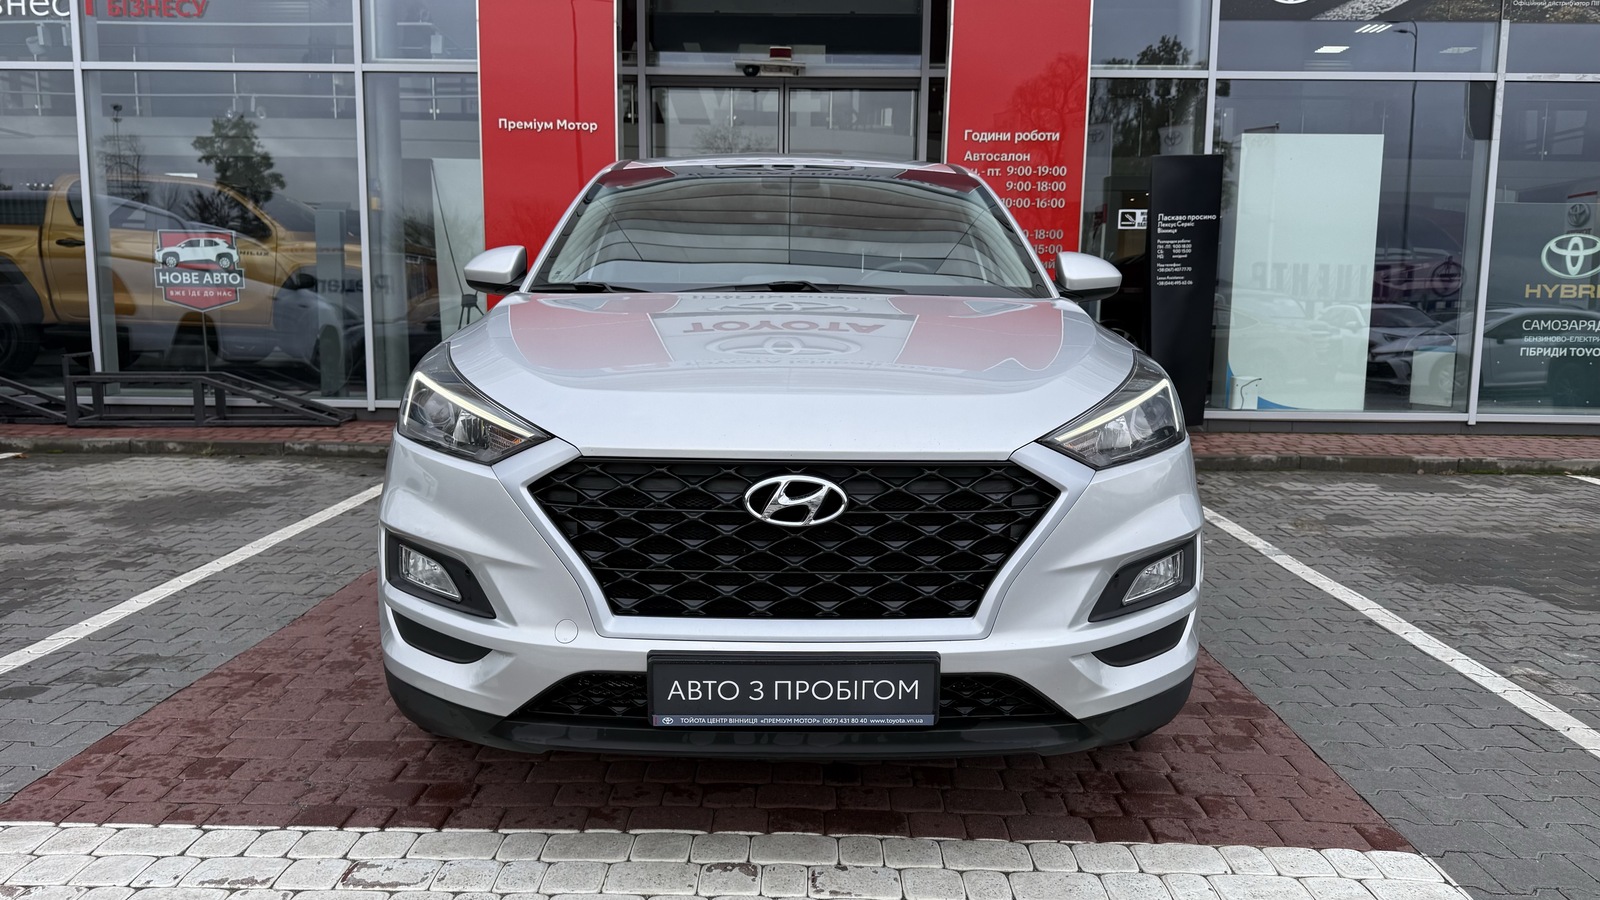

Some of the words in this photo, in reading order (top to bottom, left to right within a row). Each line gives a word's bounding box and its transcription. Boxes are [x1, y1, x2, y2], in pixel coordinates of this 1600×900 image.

[0, 0, 71, 16] нес
[107, 0, 207, 17] БІЗНЕСУ
[498, 118, 554, 132] Преміум
[556, 119, 598, 133] Мотор
[964, 129, 1011, 143] Години
[1014, 129, 1060, 144] роботи
[963, 150, 1031, 161] Автосалон
[1006, 165, 1067, 176] 9:00-19:00
[1005, 181, 1066, 192] 9:00-18:00
[1022, 228, 1064, 240] 0-18:00
[1033, 244, 1063, 255] 15:00
[159, 271, 200, 284] НОВЕ
[202, 272, 241, 285] АВТО
[1520, 346, 1567, 358] ГІБРИДИ
[667, 679, 740, 701] АВТО
[749, 680, 765, 701] З
[774, 679, 919, 701] ПРОБІГОМ
[822, 717, 839, 725] (067)
[869, 717, 924, 725] www.toyota.vn.ua
